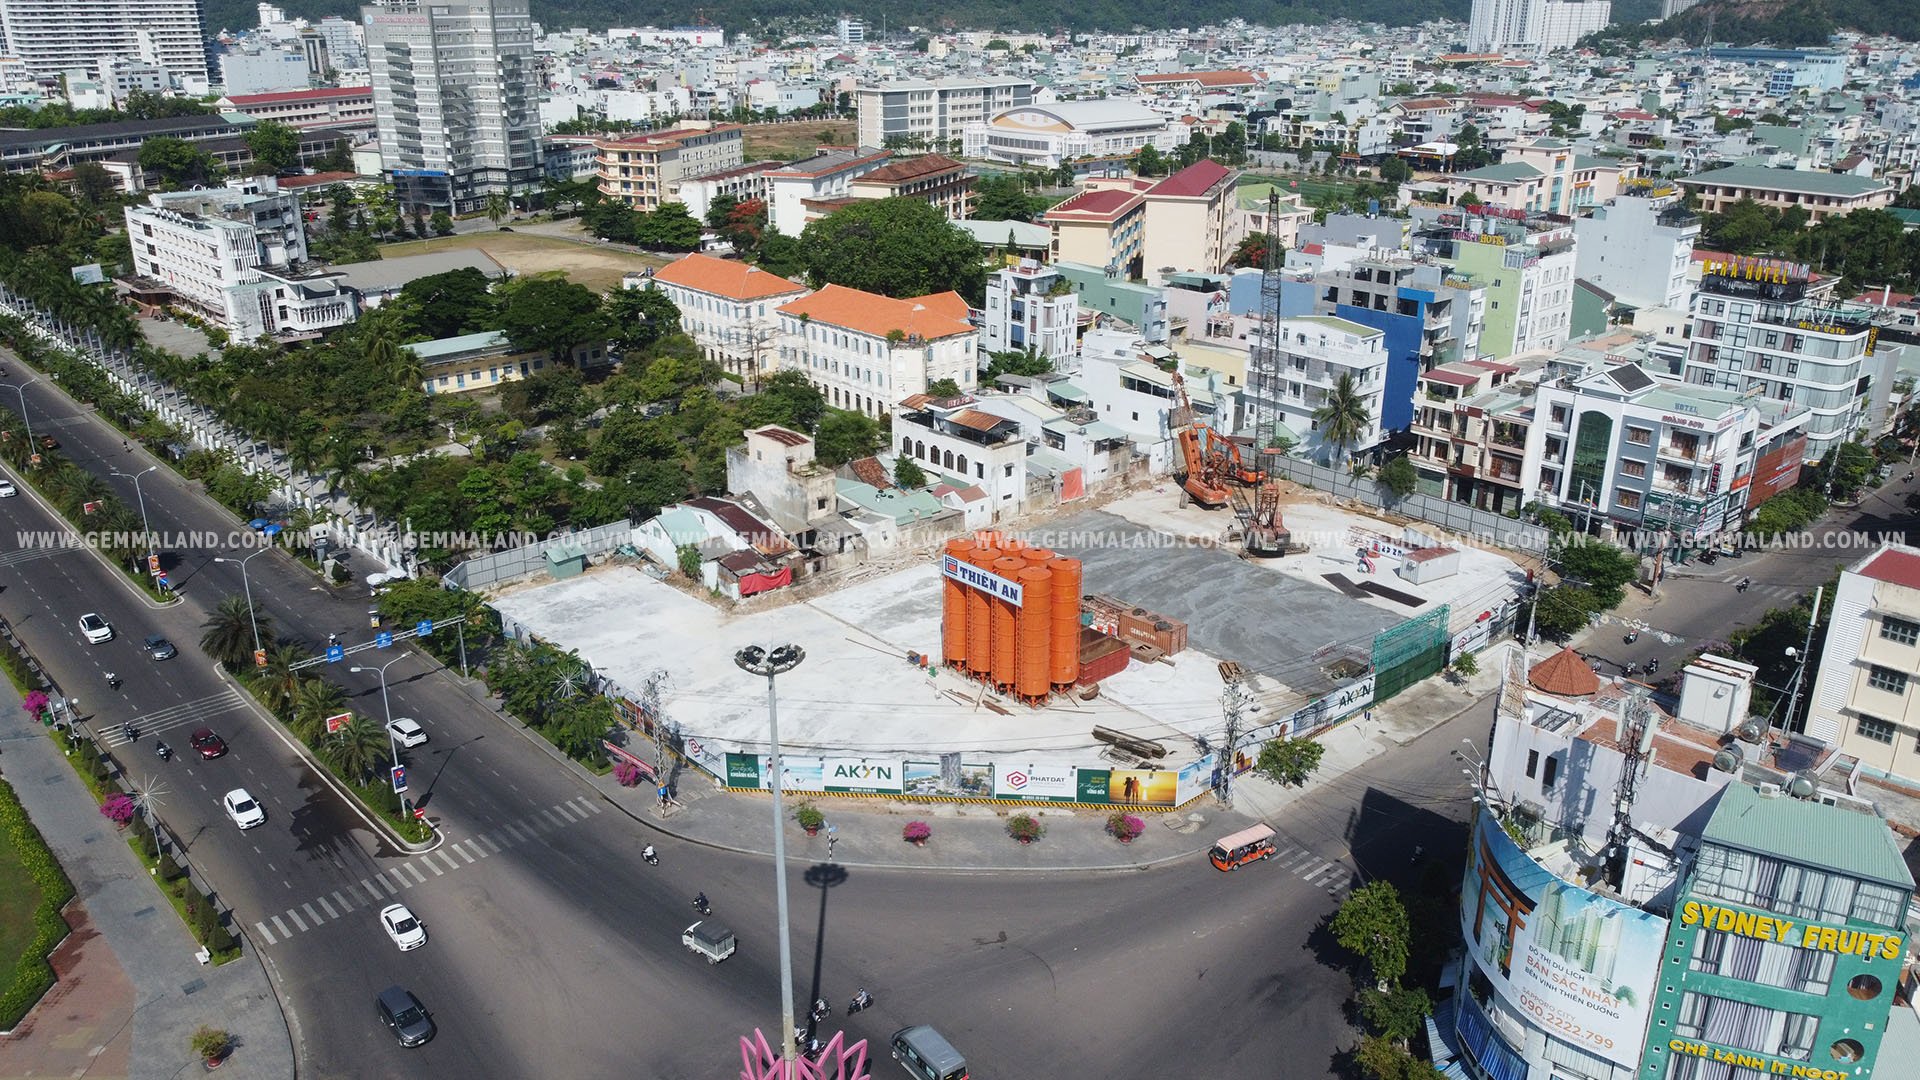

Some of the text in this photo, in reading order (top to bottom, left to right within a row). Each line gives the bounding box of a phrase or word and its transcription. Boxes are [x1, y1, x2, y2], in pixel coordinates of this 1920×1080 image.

[1480, 233, 1505, 246] HOTEL
[1746, 265, 1788, 285] HOTEL
[1674, 403, 1698, 413] HOTEL
[960, 566, 1019, 601] THIÊN AN
[1339, 682, 1372, 710] AKYN
[834, 764, 892, 780] AKYN
[1682, 901, 1902, 960] SYDNEY FRUITS
[1552, 961, 1565, 972] DU
[1522, 986, 1577, 1022] SAPPORO CITY
[1559, 988, 1585, 1005] THIÊN
[1519, 994, 1615, 1051] 090.2222.799
[1669, 1039, 1708, 1057] CHÈ
[1713, 1048, 1765, 1070] LẠNH
[1770, 1059, 1788, 1074] ÍT
